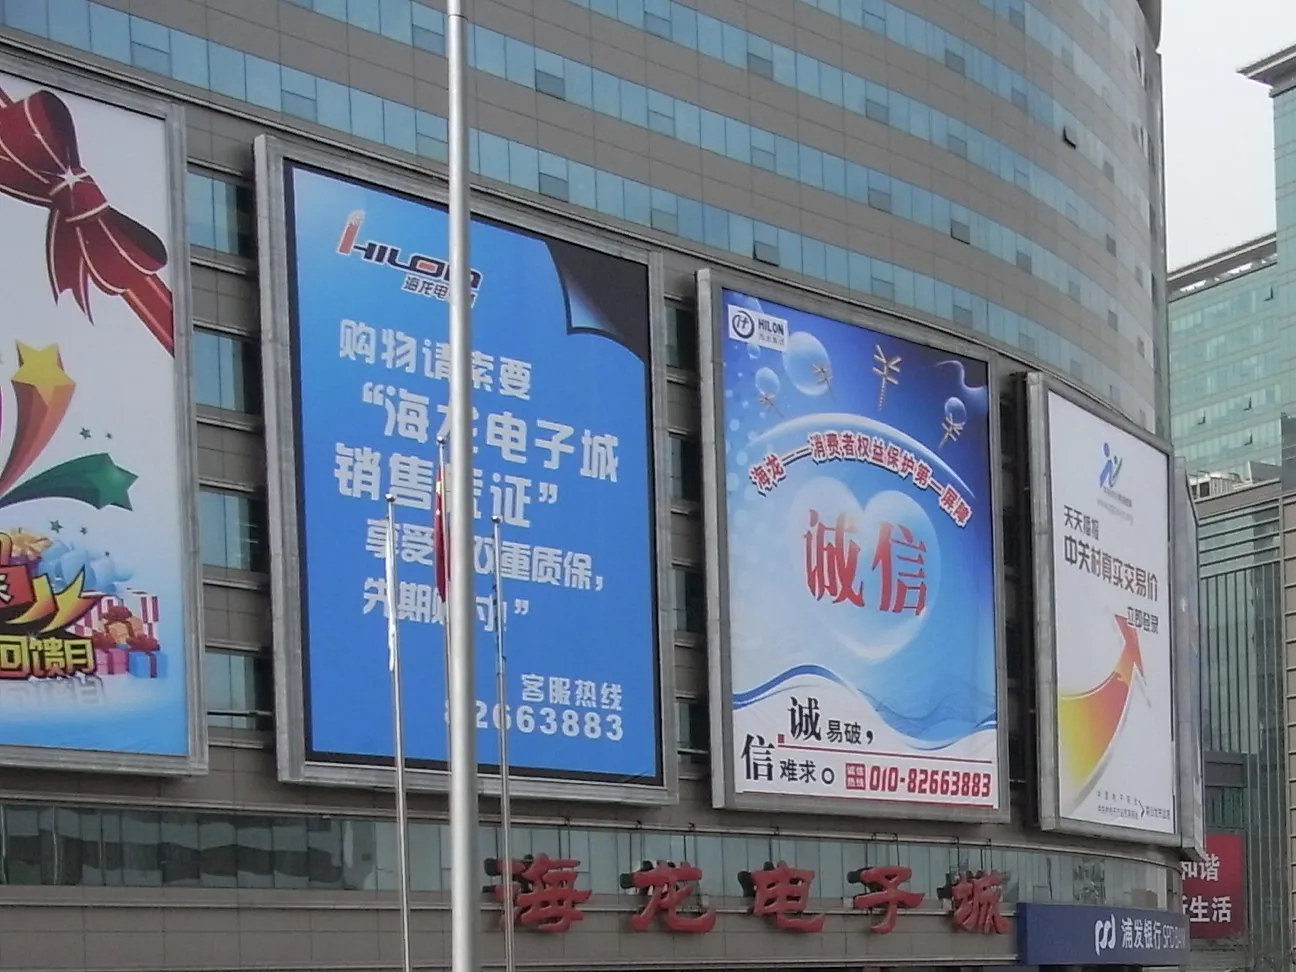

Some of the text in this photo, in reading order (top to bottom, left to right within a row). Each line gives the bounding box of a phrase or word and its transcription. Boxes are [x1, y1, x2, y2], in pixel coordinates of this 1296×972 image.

[758, 318, 785, 336] HILON
[803, 509, 927, 616] 诚信
[520, 673, 623, 711] 客服热线
[445, 699, 624, 741] 2663883
[869, 765, 992, 798] 010-82663883
[1181, 854, 1220, 881] 和谐
[493, 853, 1010, 934] 海龙电子城
[1121, 917, 1162, 949] 浦发银行
